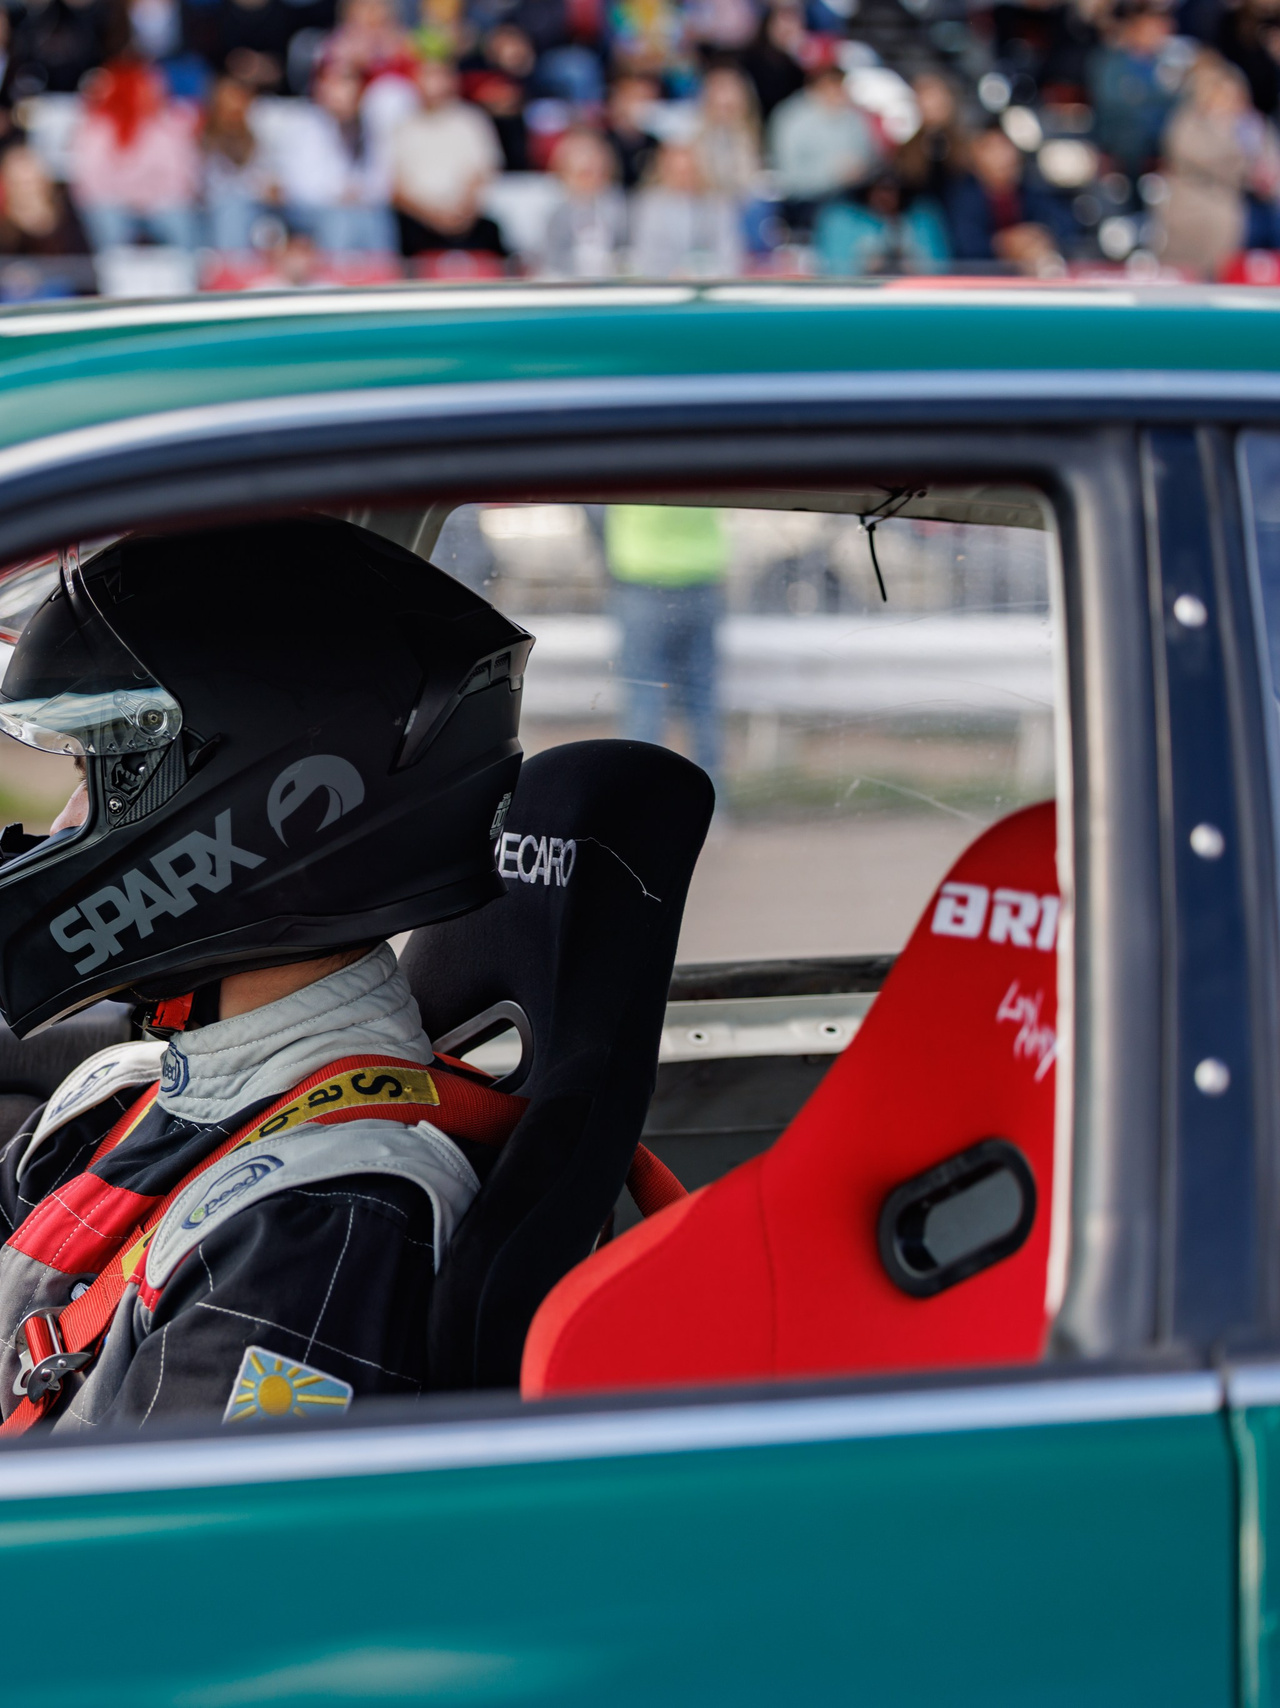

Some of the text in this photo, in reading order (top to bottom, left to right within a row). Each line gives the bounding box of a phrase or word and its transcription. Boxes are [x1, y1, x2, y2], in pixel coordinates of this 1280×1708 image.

[50, 808, 267, 976] SPARX
[495, 832, 577, 887] ECARO
[931, 881, 1060, 952] BRI
